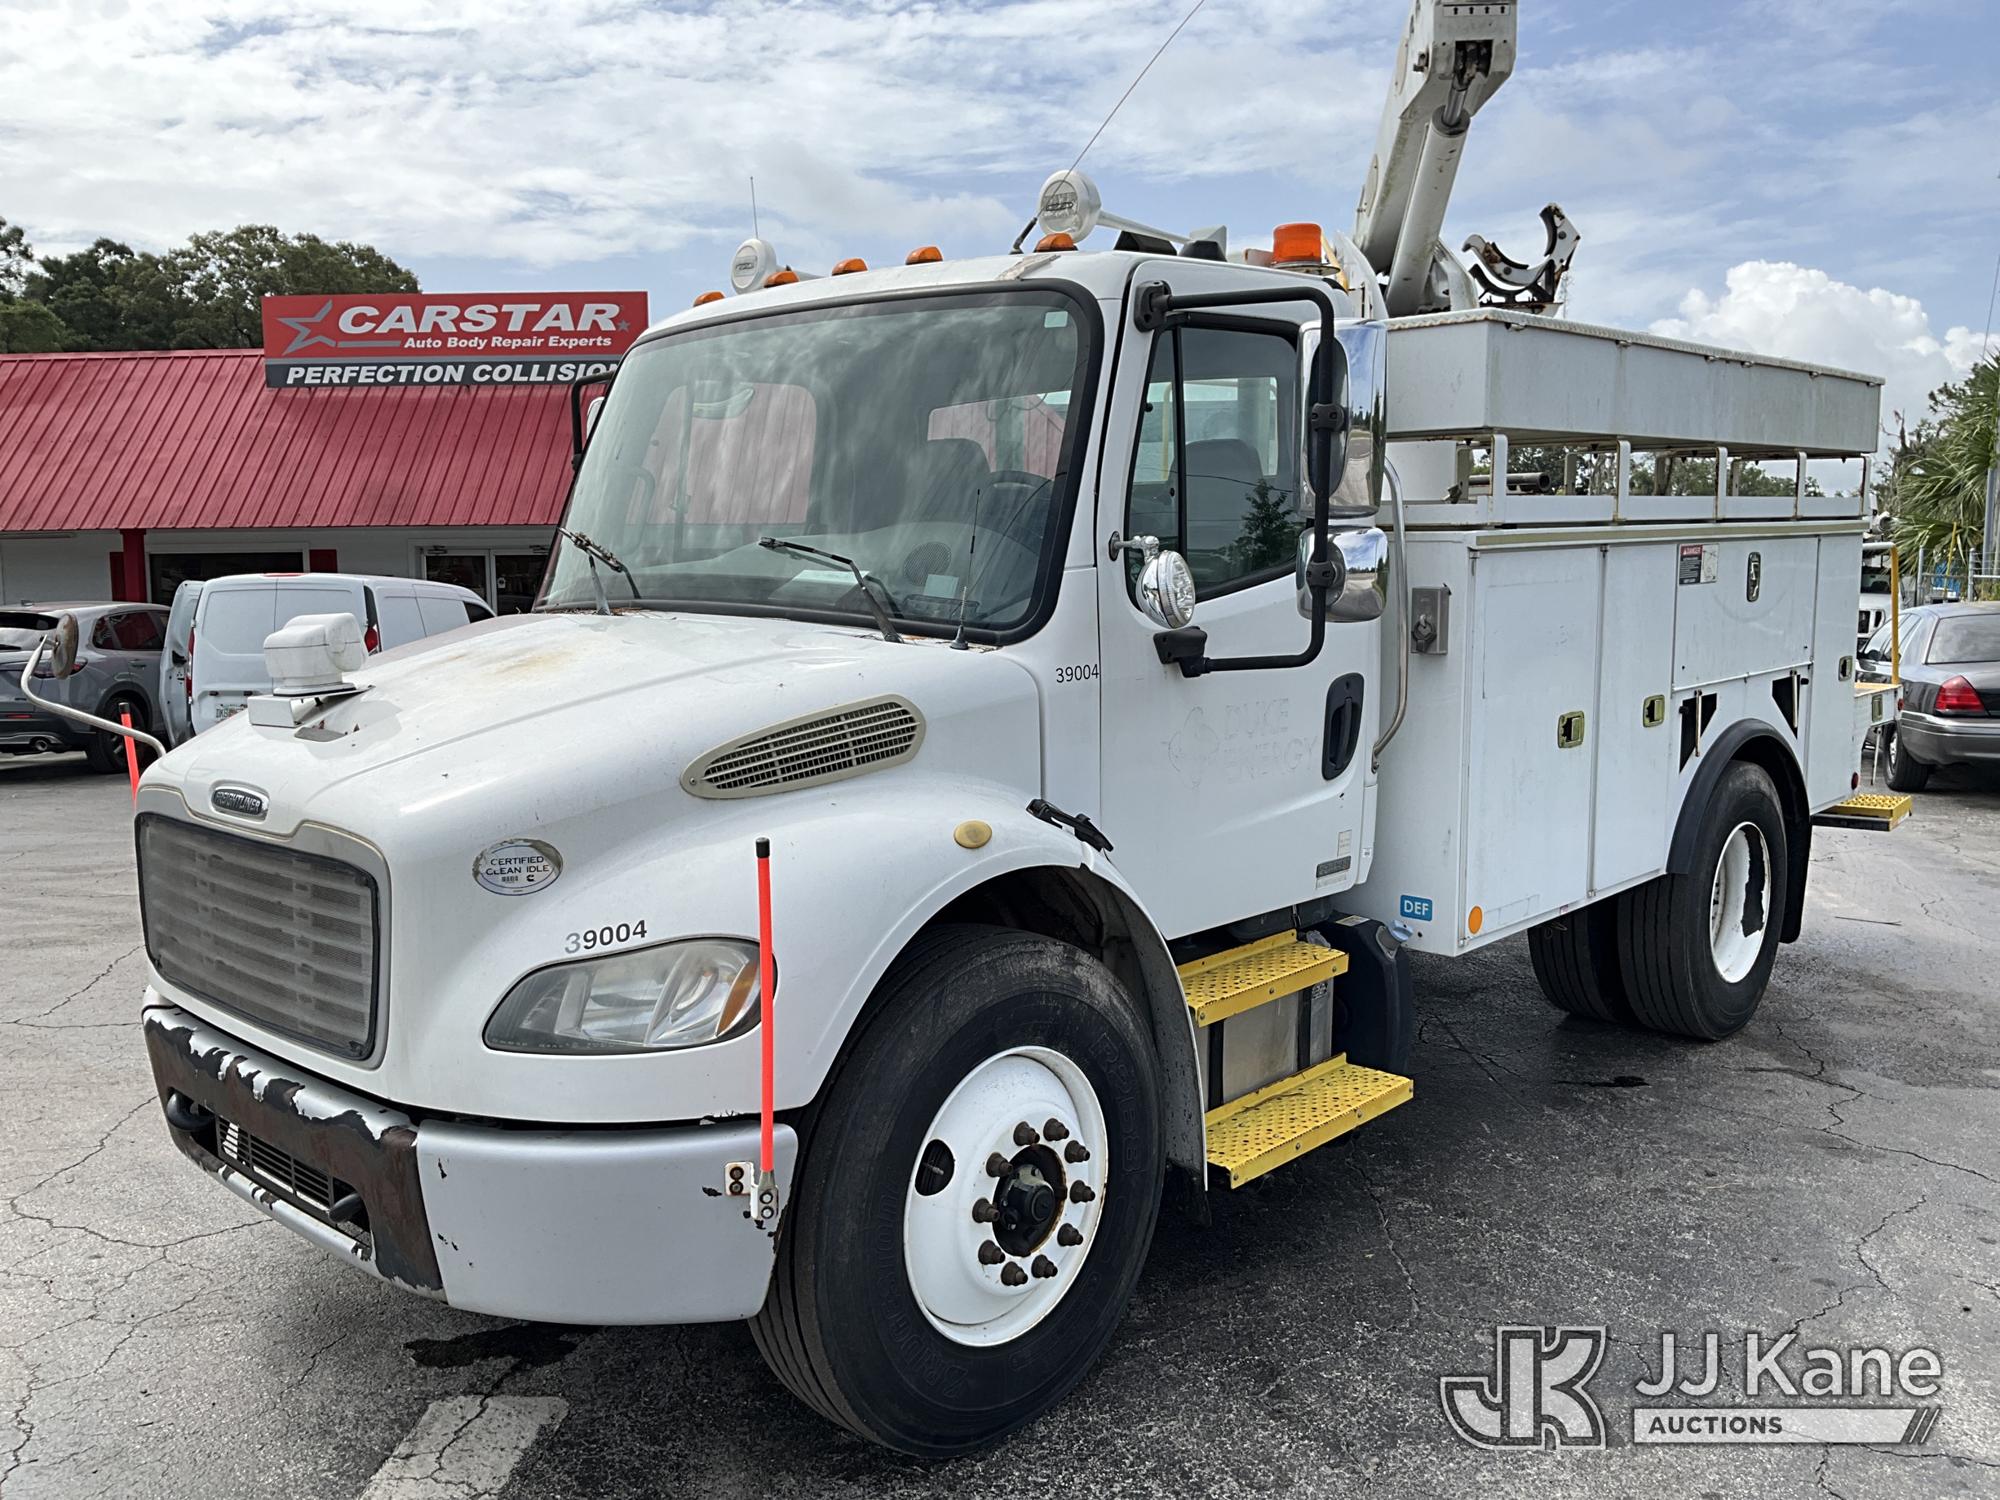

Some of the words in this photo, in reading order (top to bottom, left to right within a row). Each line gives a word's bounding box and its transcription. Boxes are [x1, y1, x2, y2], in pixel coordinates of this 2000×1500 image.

[338, 303, 621, 334] CARSTAR
[404, 337, 442, 349] Auto
[447, 336, 488, 351] Body
[491, 335, 545, 349] Repair
[548, 335, 612, 349] Experts
[286, 364, 466, 385] PERFECTION
[1055, 663, 1100, 683] 39004
[490, 855, 544, 866] CERTIFIED
[485, 866, 522, 876] CLEAN
[526, 864, 550, 873] IDLE
[1403, 899, 1429, 916] DEF
[564, 919, 647, 955] 39004
